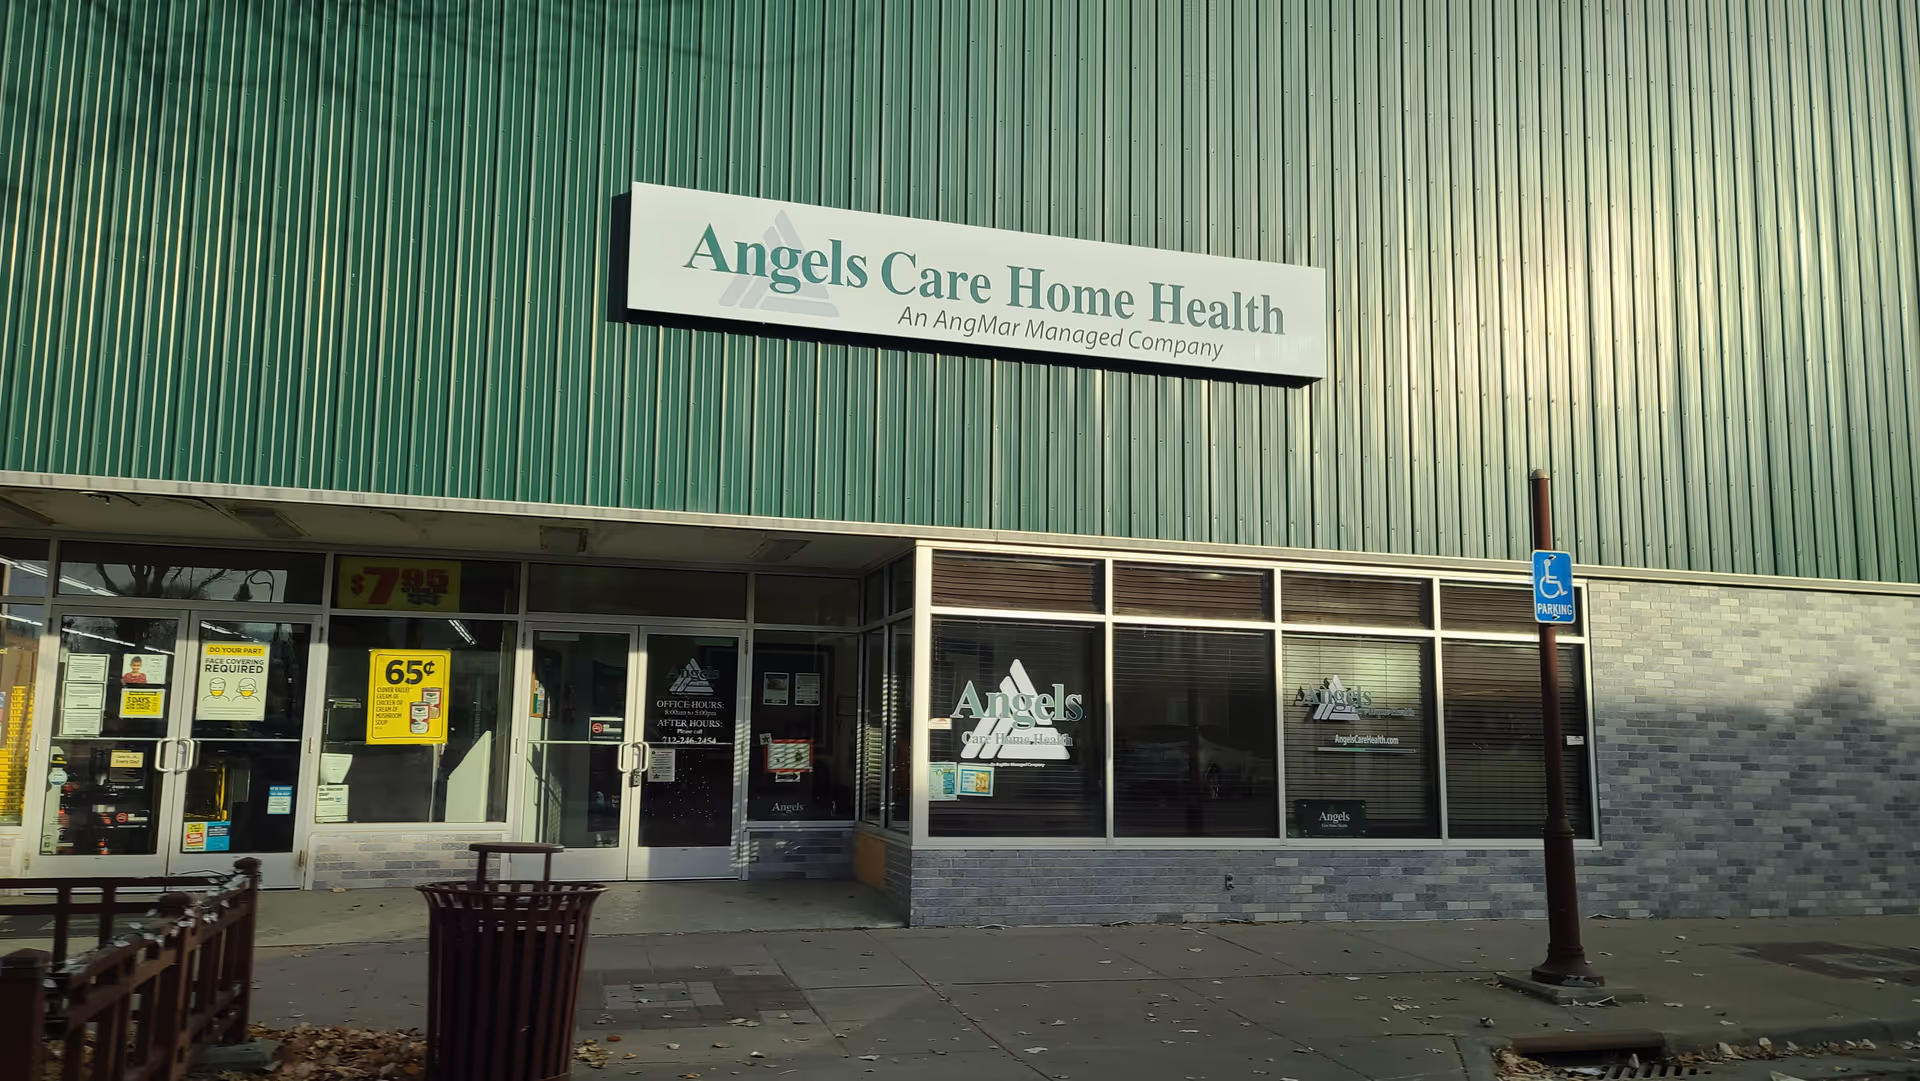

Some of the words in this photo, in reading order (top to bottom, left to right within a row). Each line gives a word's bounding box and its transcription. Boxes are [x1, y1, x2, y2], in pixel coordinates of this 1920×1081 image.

[682, 223, 868, 294] Angels
[881, 251, 992, 304] Care
[1006, 265, 1135, 320] Home
[1149, 281, 1286, 336] Health
[898, 306, 928, 327] An
[933, 309, 1020, 337] AngMar
[1025, 319, 1124, 350] Managed
[1128, 330, 1224, 362] Company
[1537, 603, 1573, 615] PARKING
[205, 664, 264, 673] REQUIRED
[385, 659, 435, 685] 65¢
[1300, 681, 1372, 711] Angels
[656, 700, 690, 709] OFFICE
[691, 701, 725, 709] HOURS:
[950, 680, 1084, 730] Angels
[656, 719, 687, 727] AFTER
[689, 719, 724, 727] HOURS:
[662, 736, 717, 744] 712-246-2454
[961, 731, 991, 745] Care
[995, 732, 1031, 746] Home
[1033, 733, 1074, 747] Health
[1334, 734, 1399, 746] AngelsCareHealth.com
[771, 802, 805, 813] Angels
[1318, 811, 1351, 824] Angels
